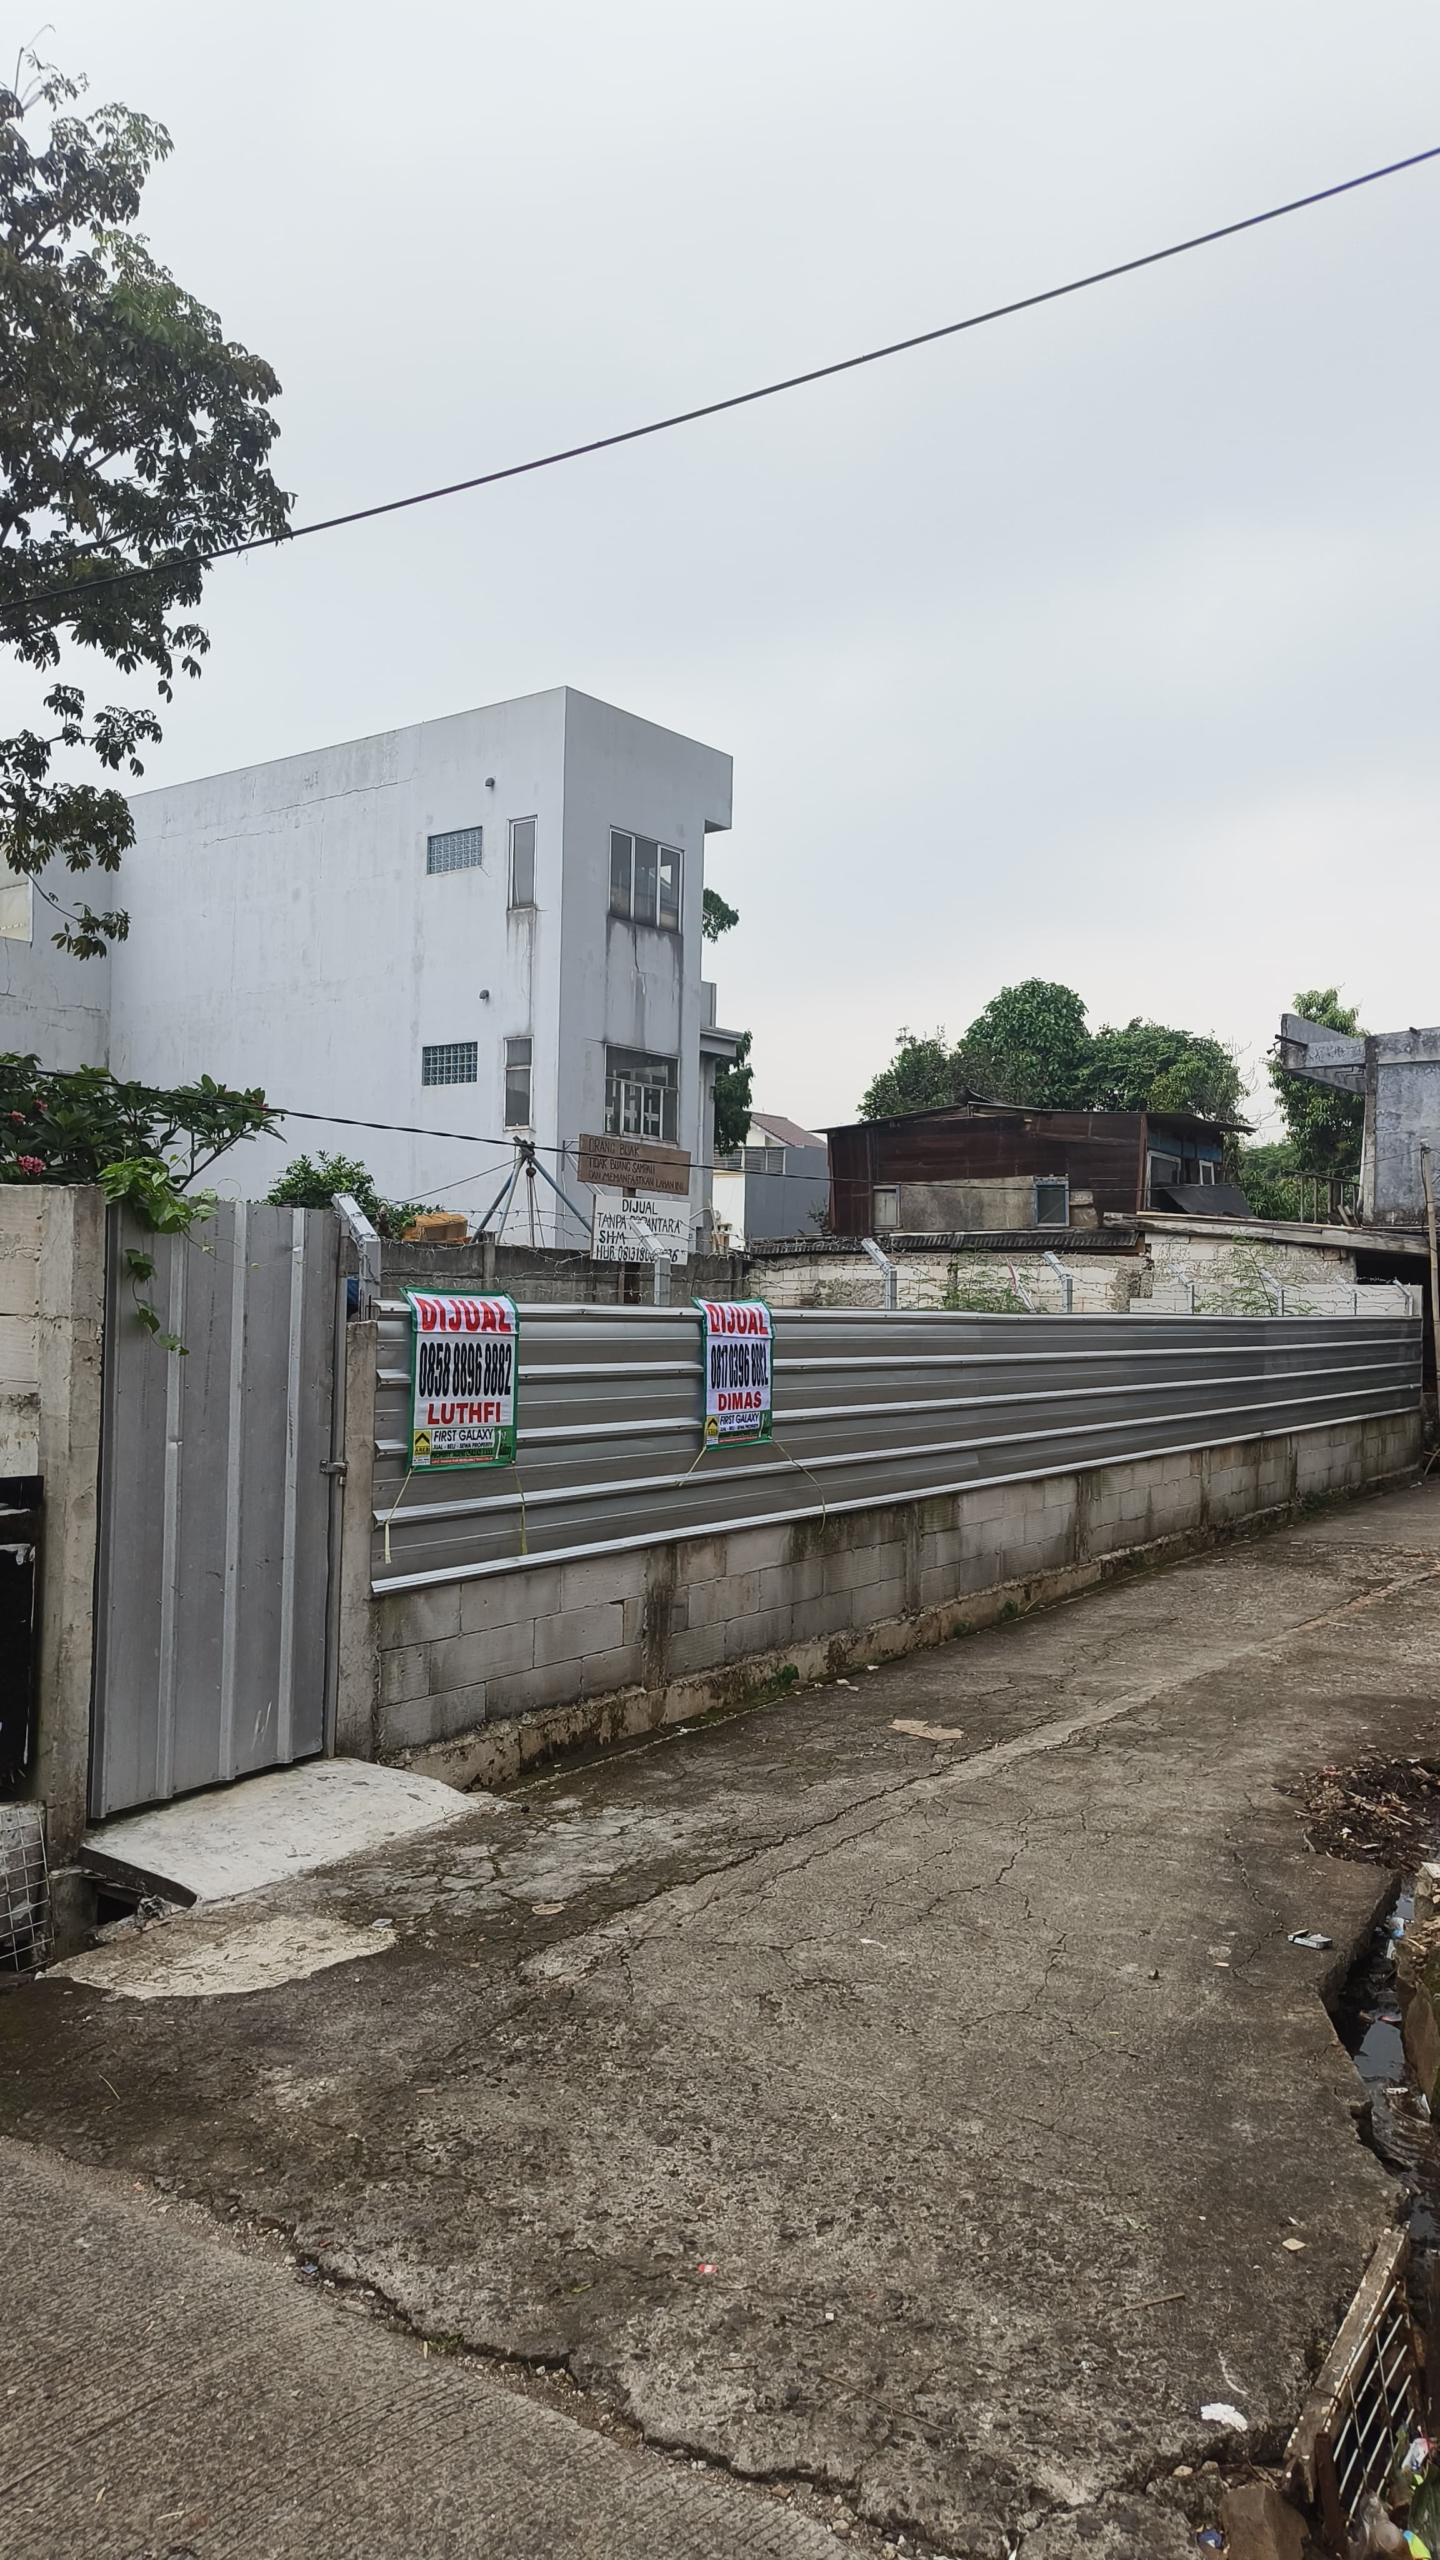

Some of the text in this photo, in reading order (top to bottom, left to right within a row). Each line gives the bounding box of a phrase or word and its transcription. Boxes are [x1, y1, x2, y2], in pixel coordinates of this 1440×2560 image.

[589, 1138, 615, 1154] ORANG
[588, 1157, 608, 1170] TIDAK
[589, 1170, 601, 1180] DAN
[622, 1199, 658, 1215] DIJUAL
[597, 1212, 627, 1230] TANPA
[599, 1230, 626, 1245] SHM
[415, 1297, 512, 1333] DIJUAL
[705, 1303, 769, 1335] DIJUAL
[419, 1341, 512, 1398] 0858 8896 8882
[711, 1344, 728, 1390] 0817
[729, 1343, 750, 1388] 0396
[718, 1390, 762, 1411] DIMAS
[427, 1402, 501, 1425] LUTHFI
[720, 1412, 760, 1426] FIRST GALAXY
[433, 1428, 494, 1442] FIRST GALAXY
